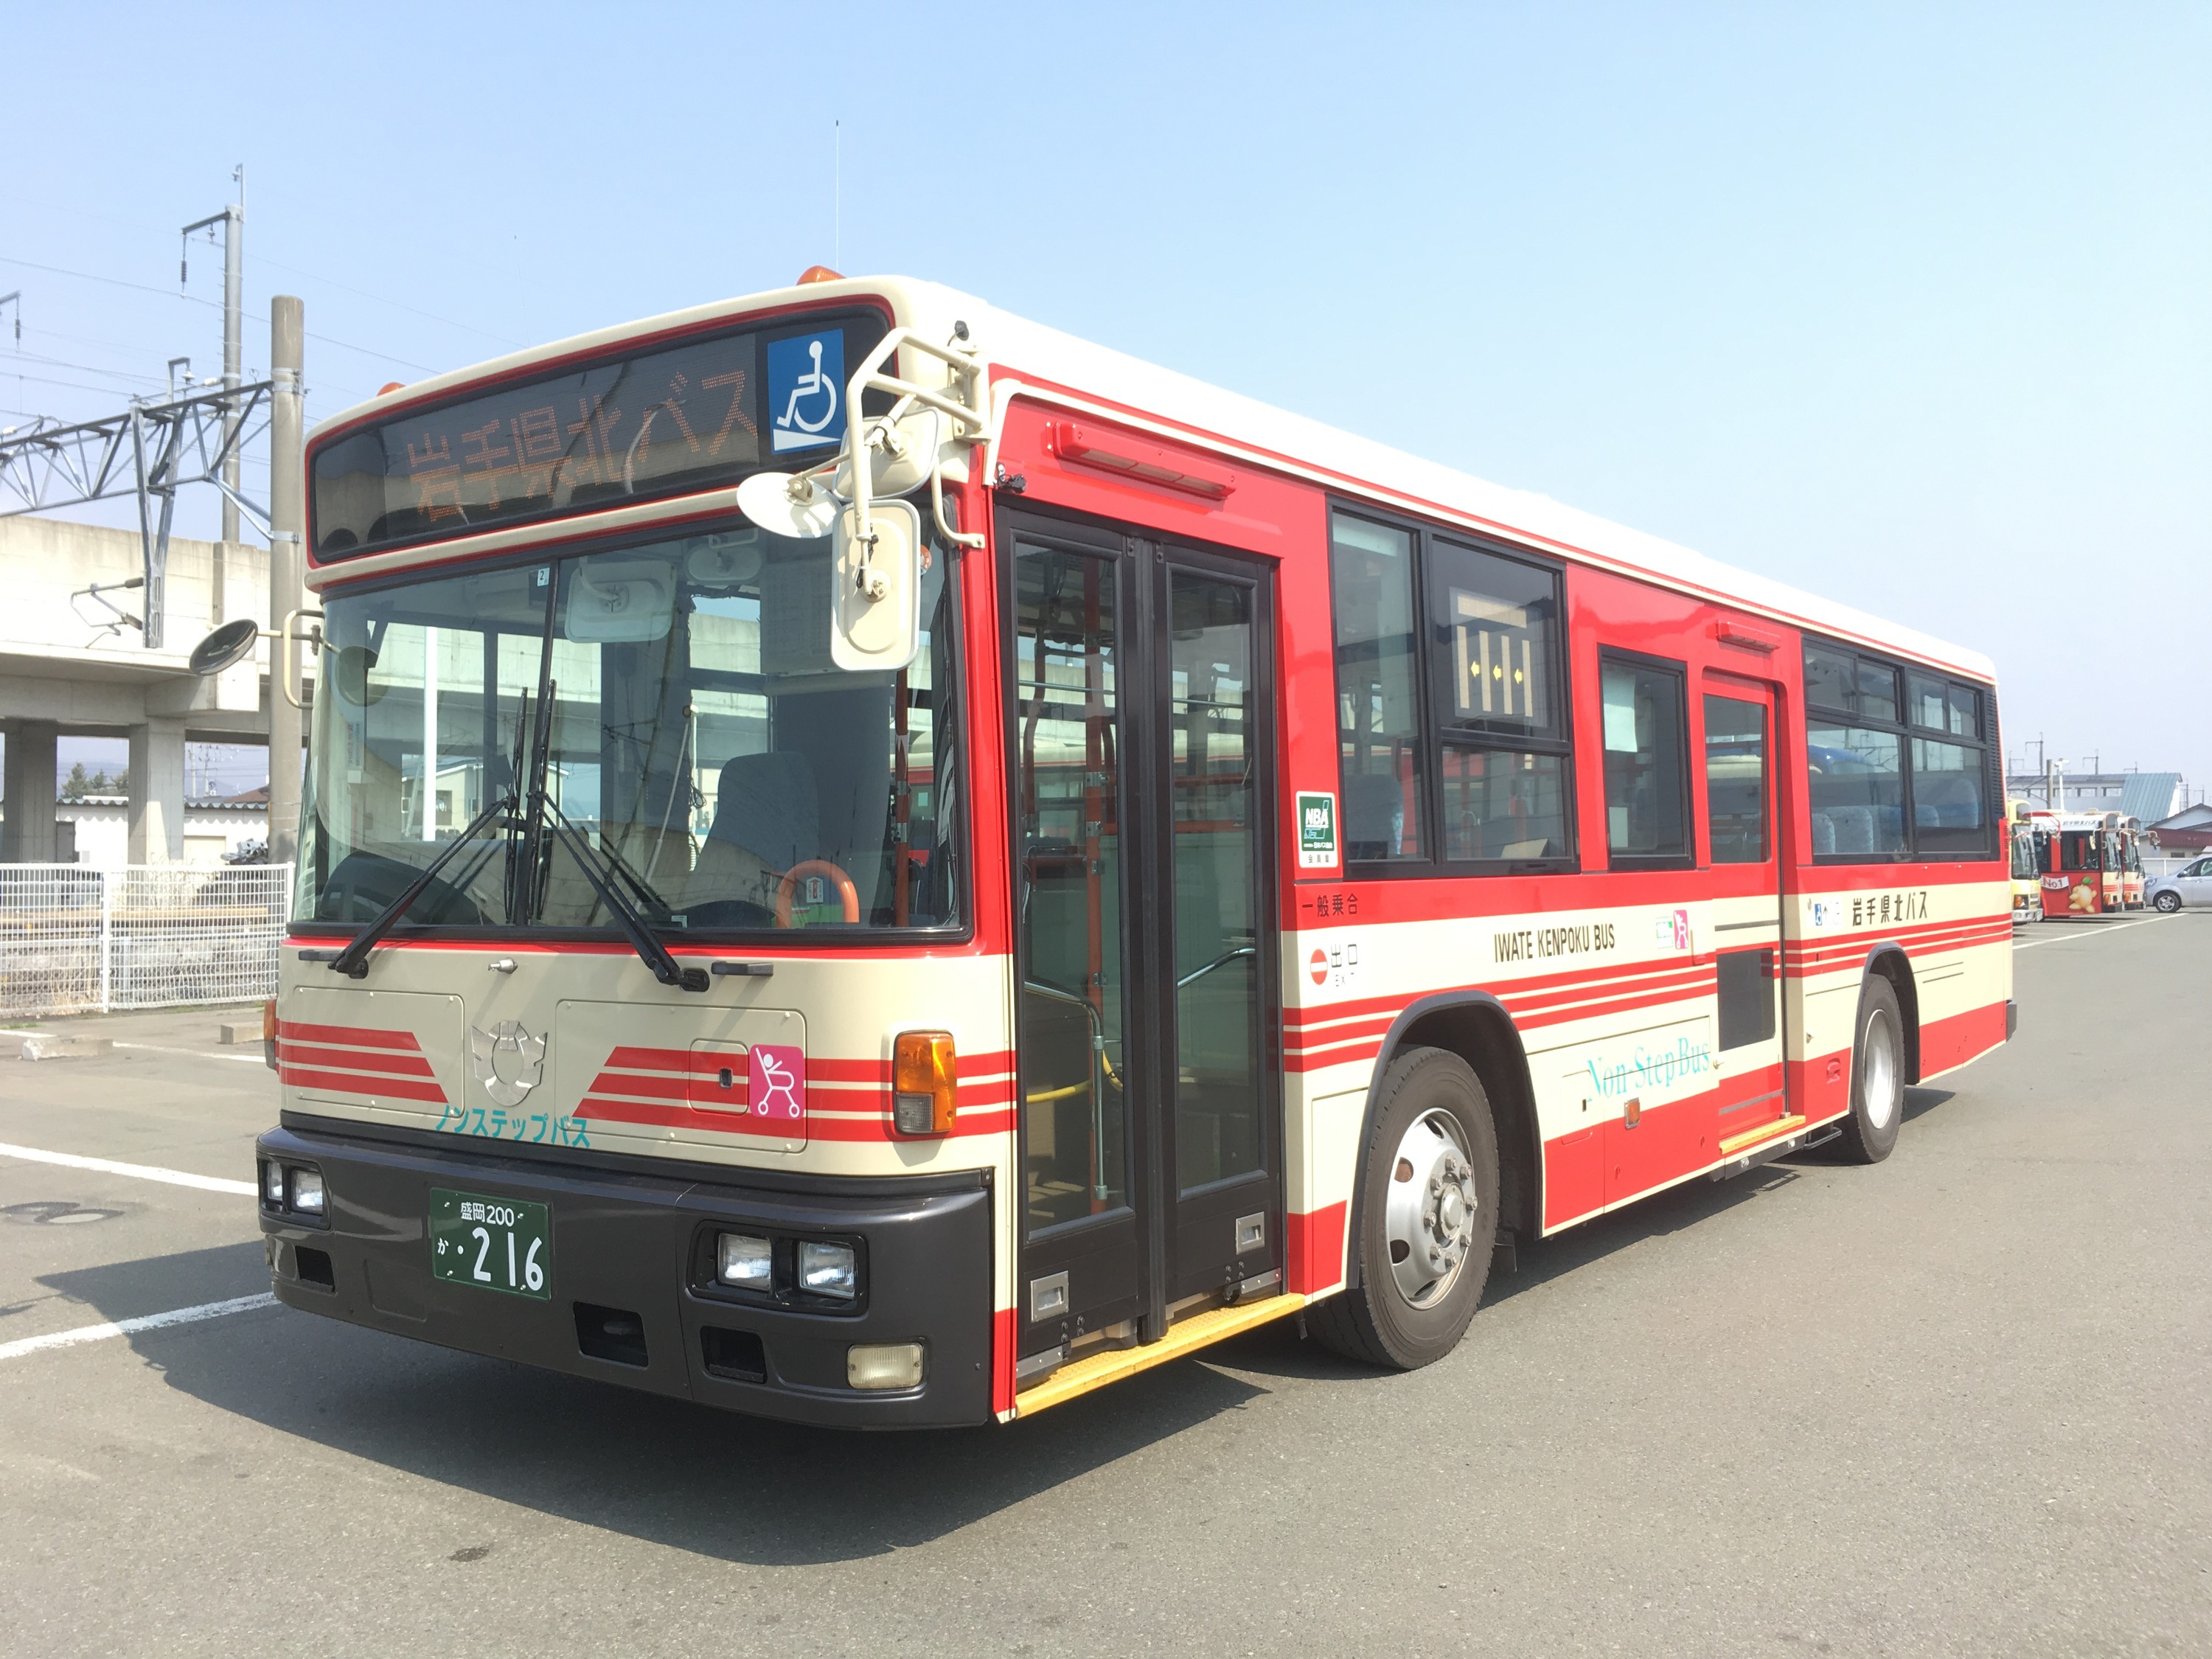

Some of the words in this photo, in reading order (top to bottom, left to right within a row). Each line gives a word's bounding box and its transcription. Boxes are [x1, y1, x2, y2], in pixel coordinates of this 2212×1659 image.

[408, 371, 758, 522] 岩手県北バス
[1305, 808, 1329, 826] NBA
[1302, 893, 1358, 917] 一般乗合
[1851, 891, 1928, 927] 岩手県北バス
[1331, 943, 1357, 968] 出口
[1494, 931, 1534, 963] IWATE
[1537, 925, 1590, 958] KENPOKU
[1593, 923, 1615, 951] BUS
[1335, 972, 1355, 987] EXT
[436, 1104, 591, 1148] ノンステップバス
